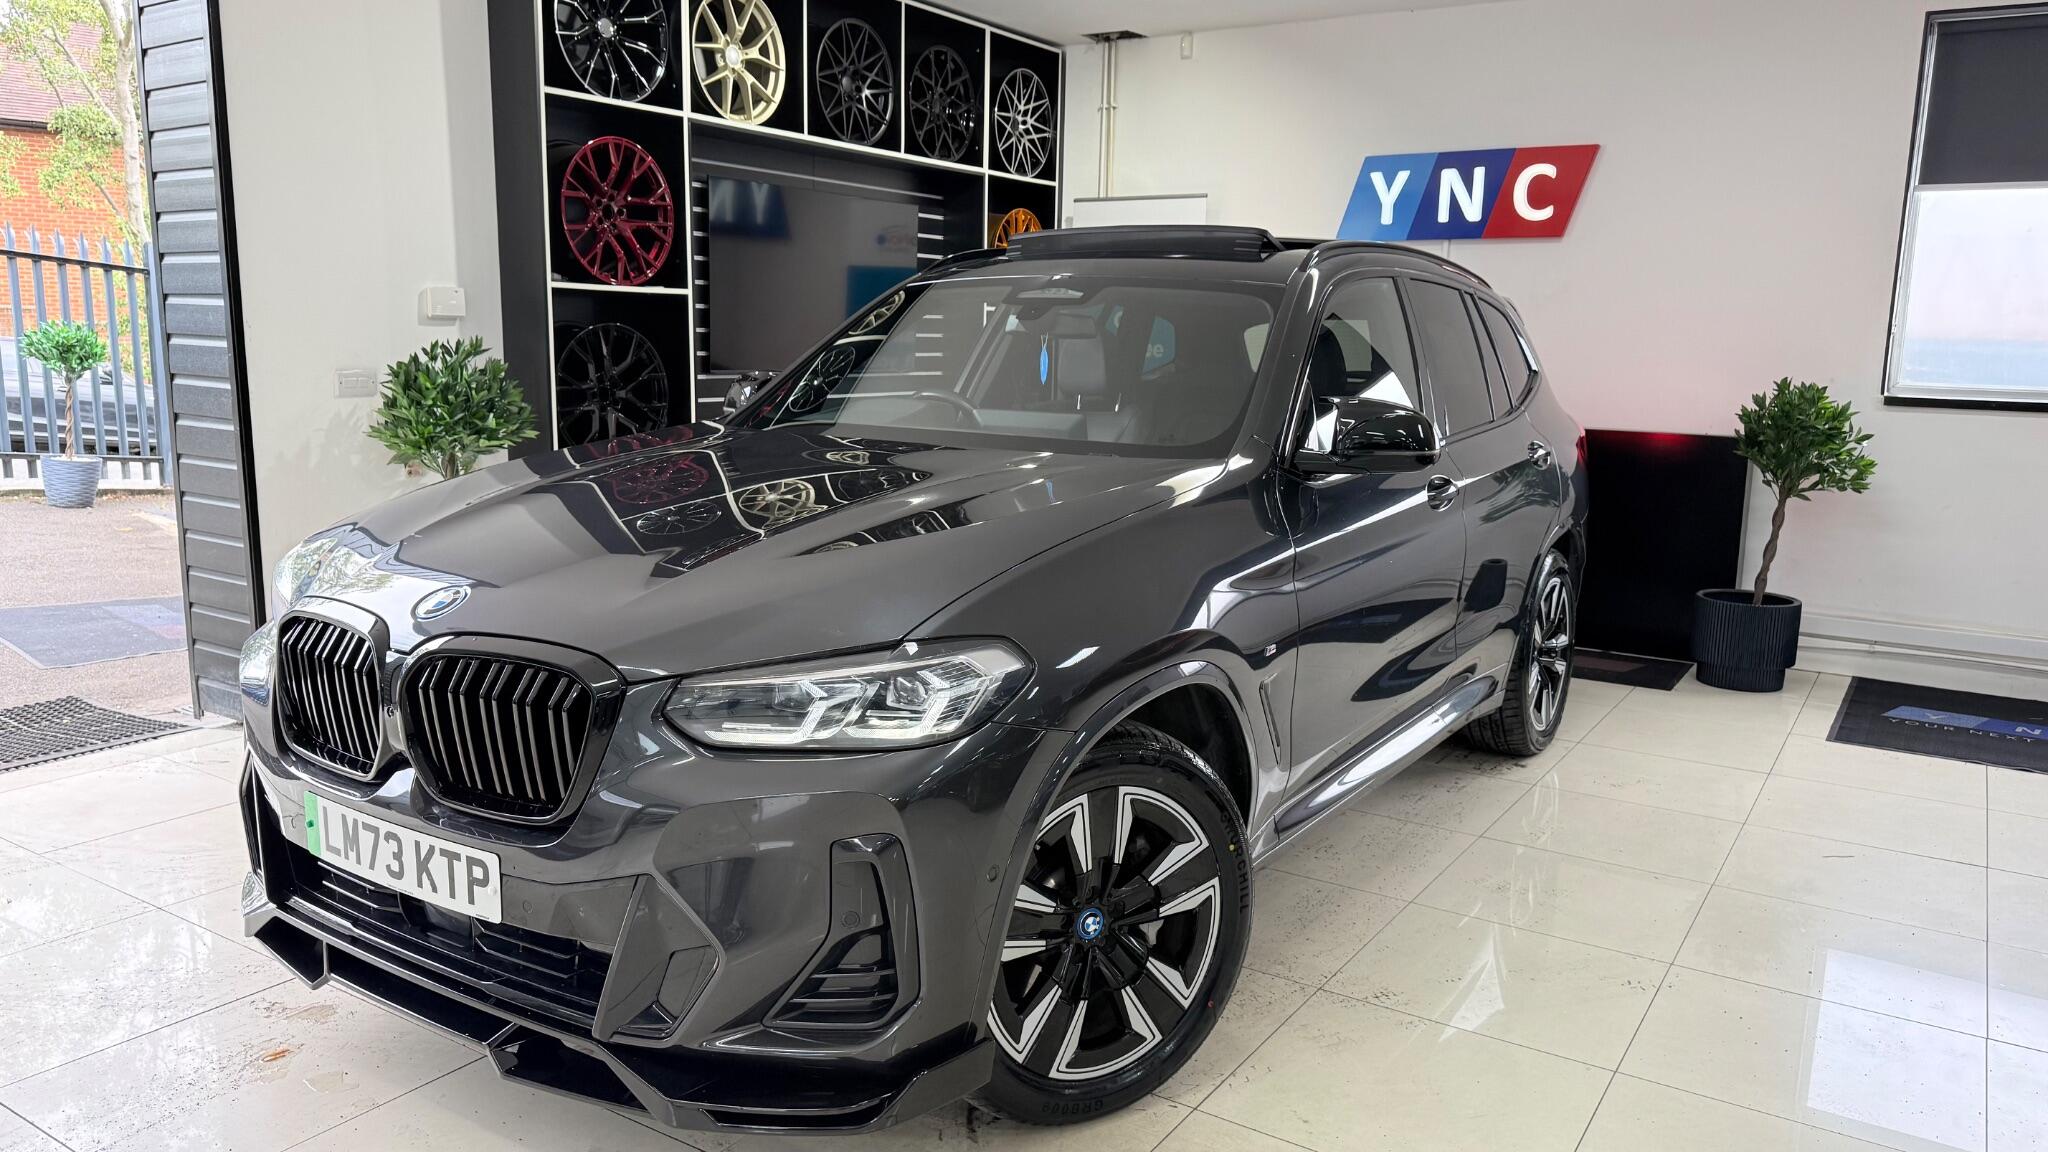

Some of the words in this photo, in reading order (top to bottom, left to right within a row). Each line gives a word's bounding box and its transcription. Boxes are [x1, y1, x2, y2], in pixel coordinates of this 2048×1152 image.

[1369, 162, 1557, 225] YNC
[1889, 717, 1955, 731] YOUR
[1969, 729, 2036, 743] NEXT
[322, 806, 405, 881] LM73
[414, 839, 490, 905] KTP
